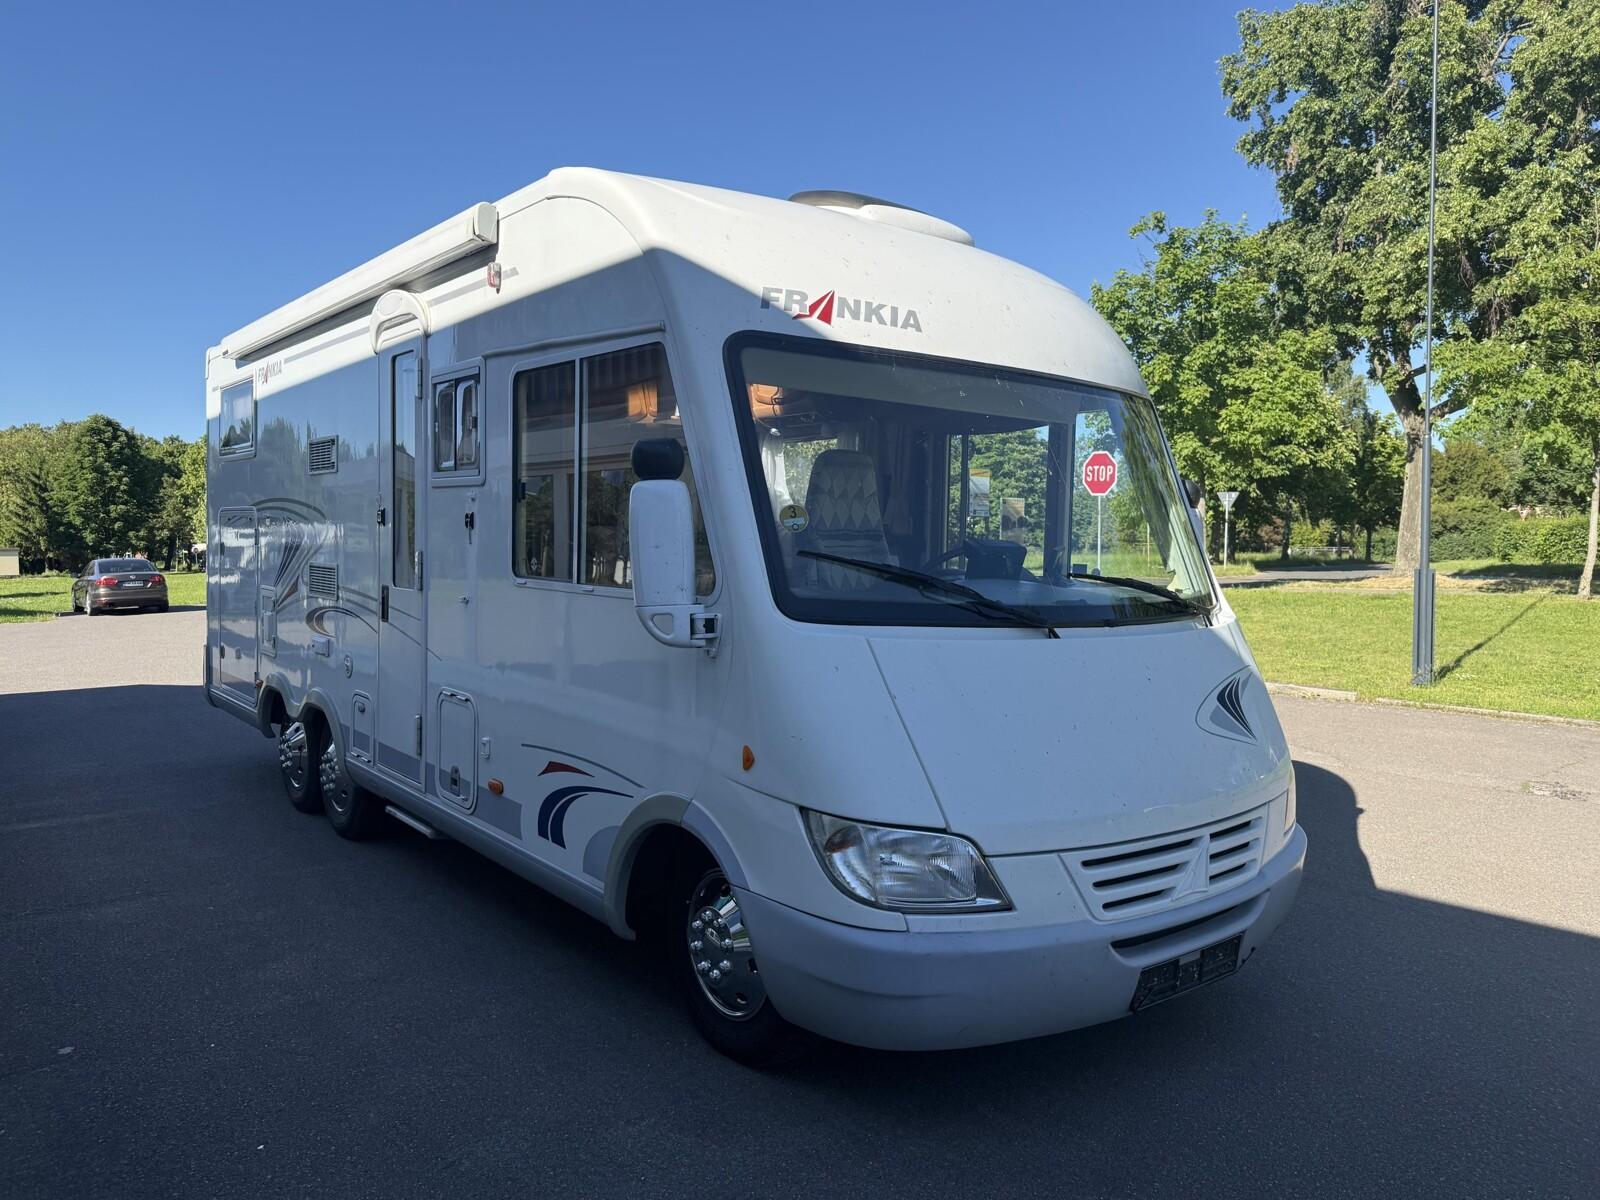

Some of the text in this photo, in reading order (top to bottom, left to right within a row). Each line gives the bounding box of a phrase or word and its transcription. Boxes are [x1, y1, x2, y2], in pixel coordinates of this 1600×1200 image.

[760, 286, 923, 333] FRANKIA
[258, 360, 282, 384] FRANKIA
[1086, 465, 1113, 482] STOP
[788, 506, 797, 518] 3
